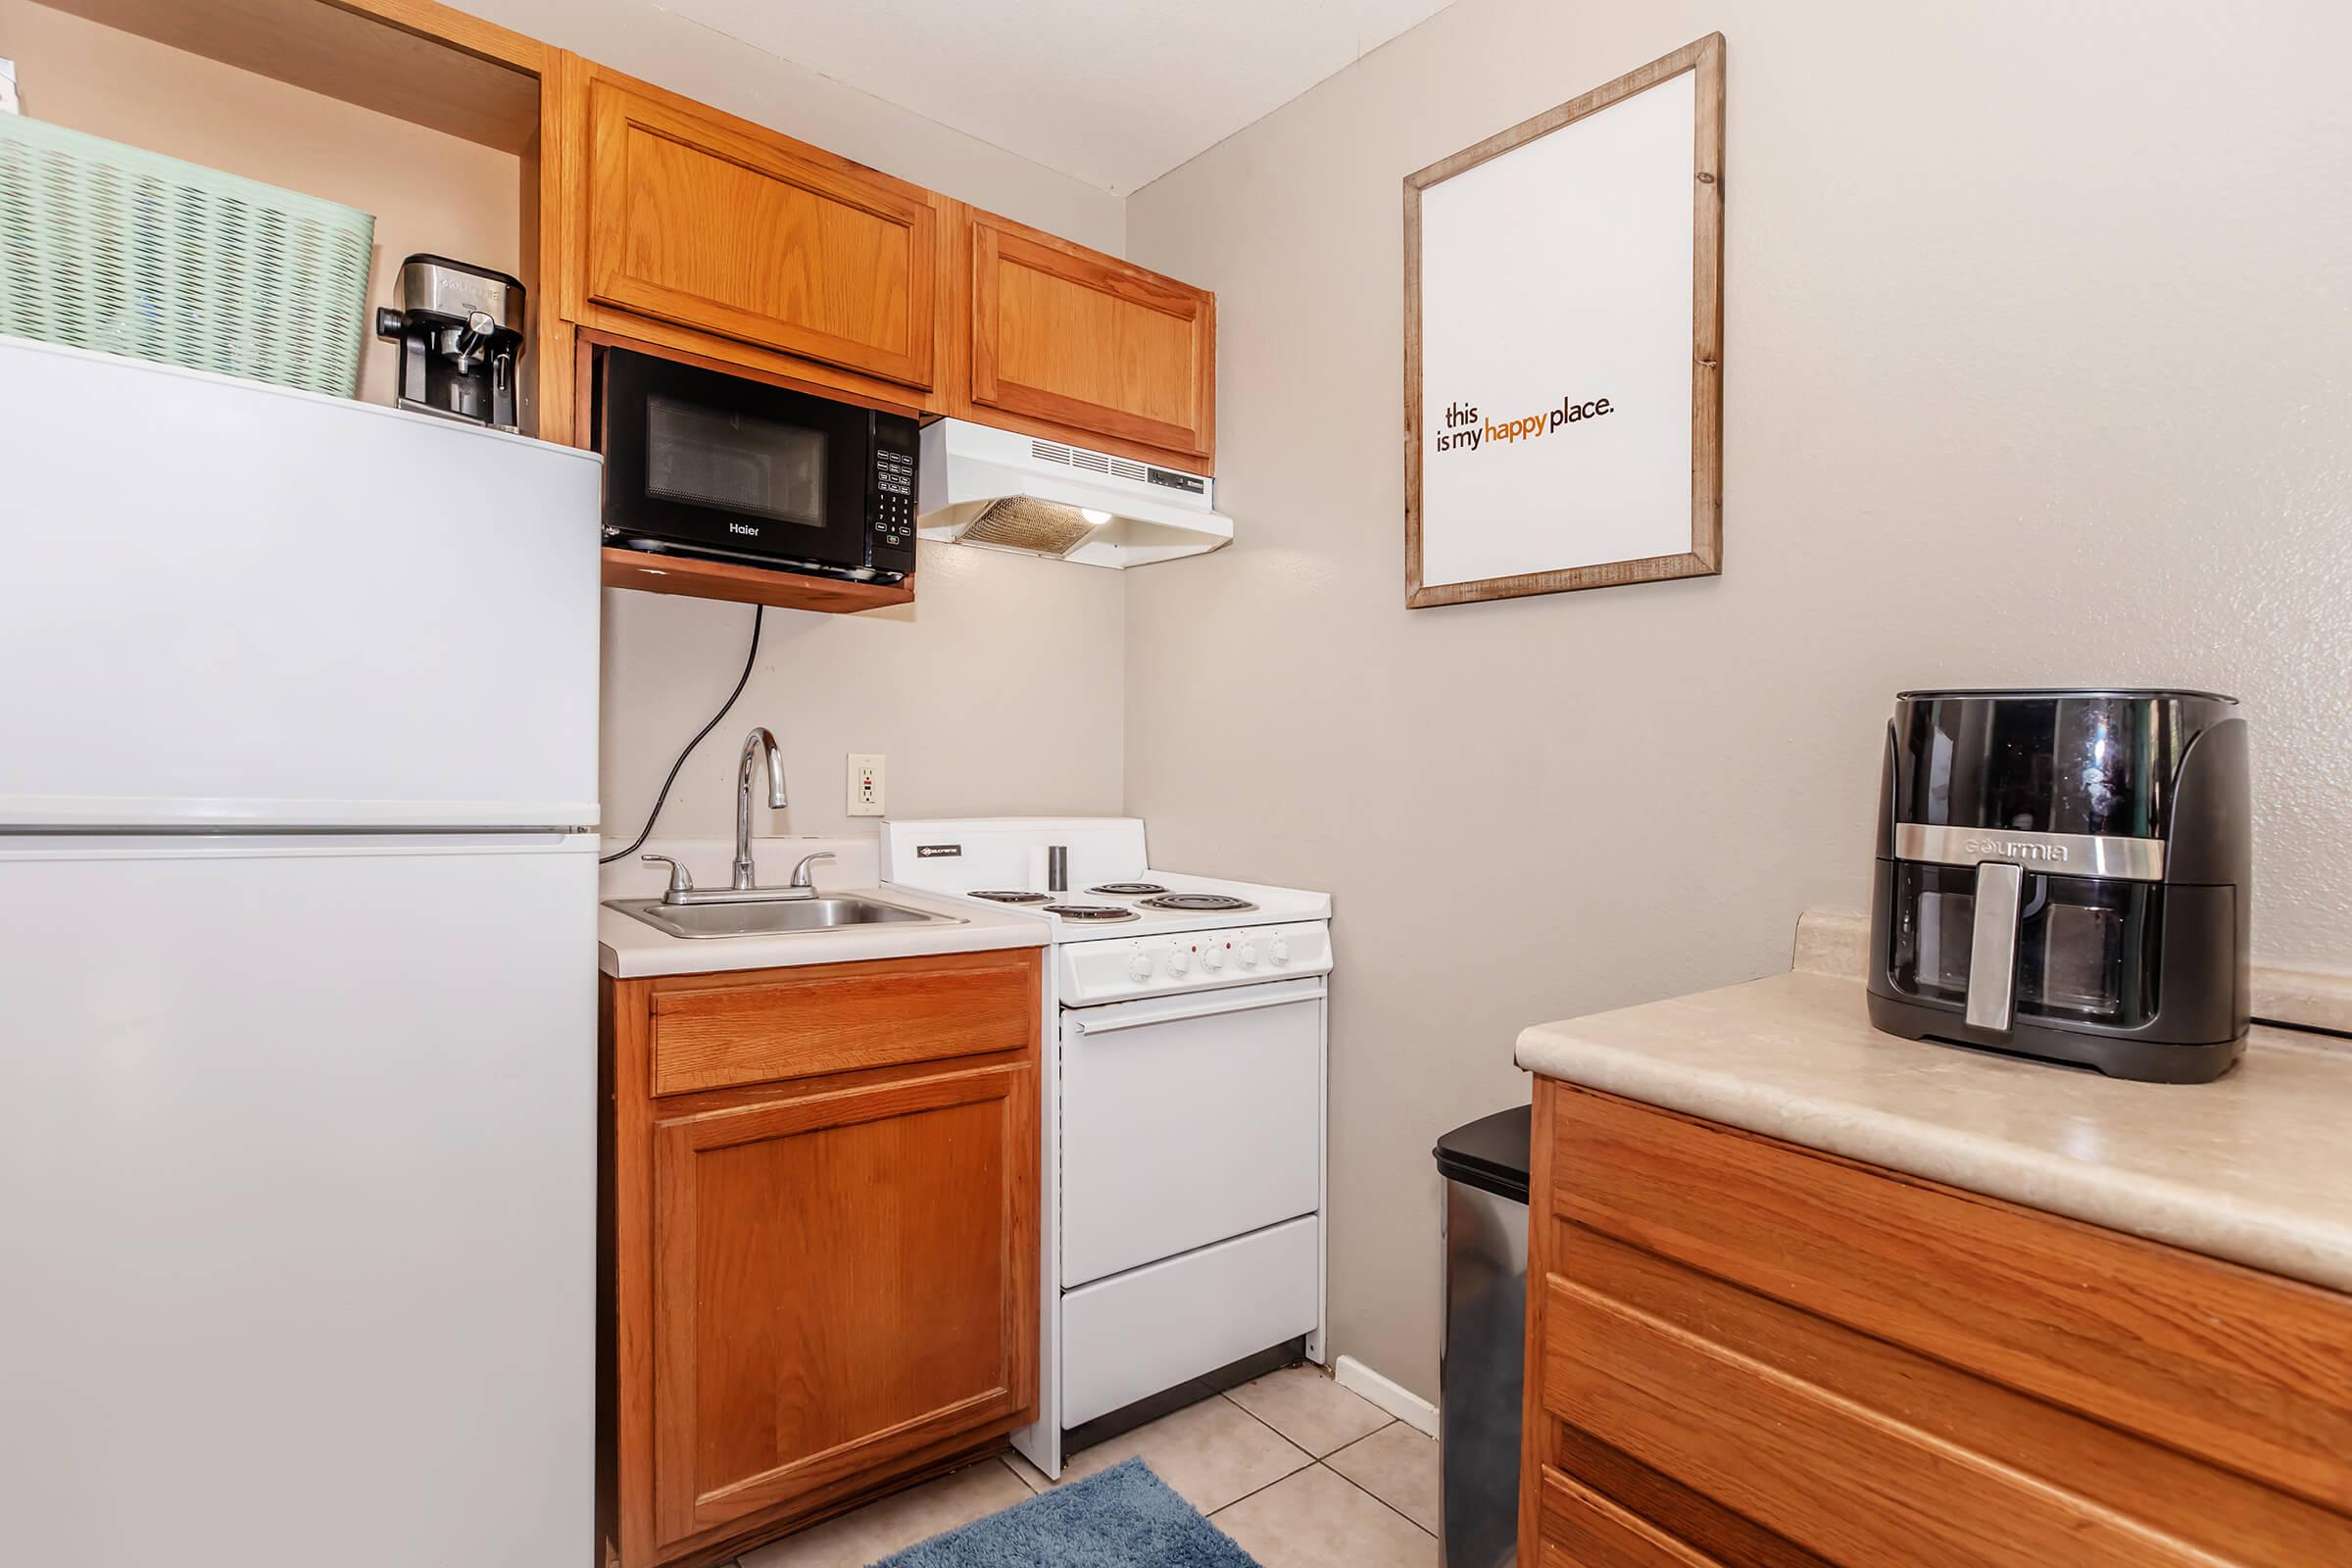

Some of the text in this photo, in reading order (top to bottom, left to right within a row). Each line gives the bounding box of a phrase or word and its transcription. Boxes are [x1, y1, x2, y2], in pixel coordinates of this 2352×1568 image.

[1437, 396, 1615, 452] is my happy place.
[1446, 402, 1478, 428] this
[729, 522, 760, 536] Haier
